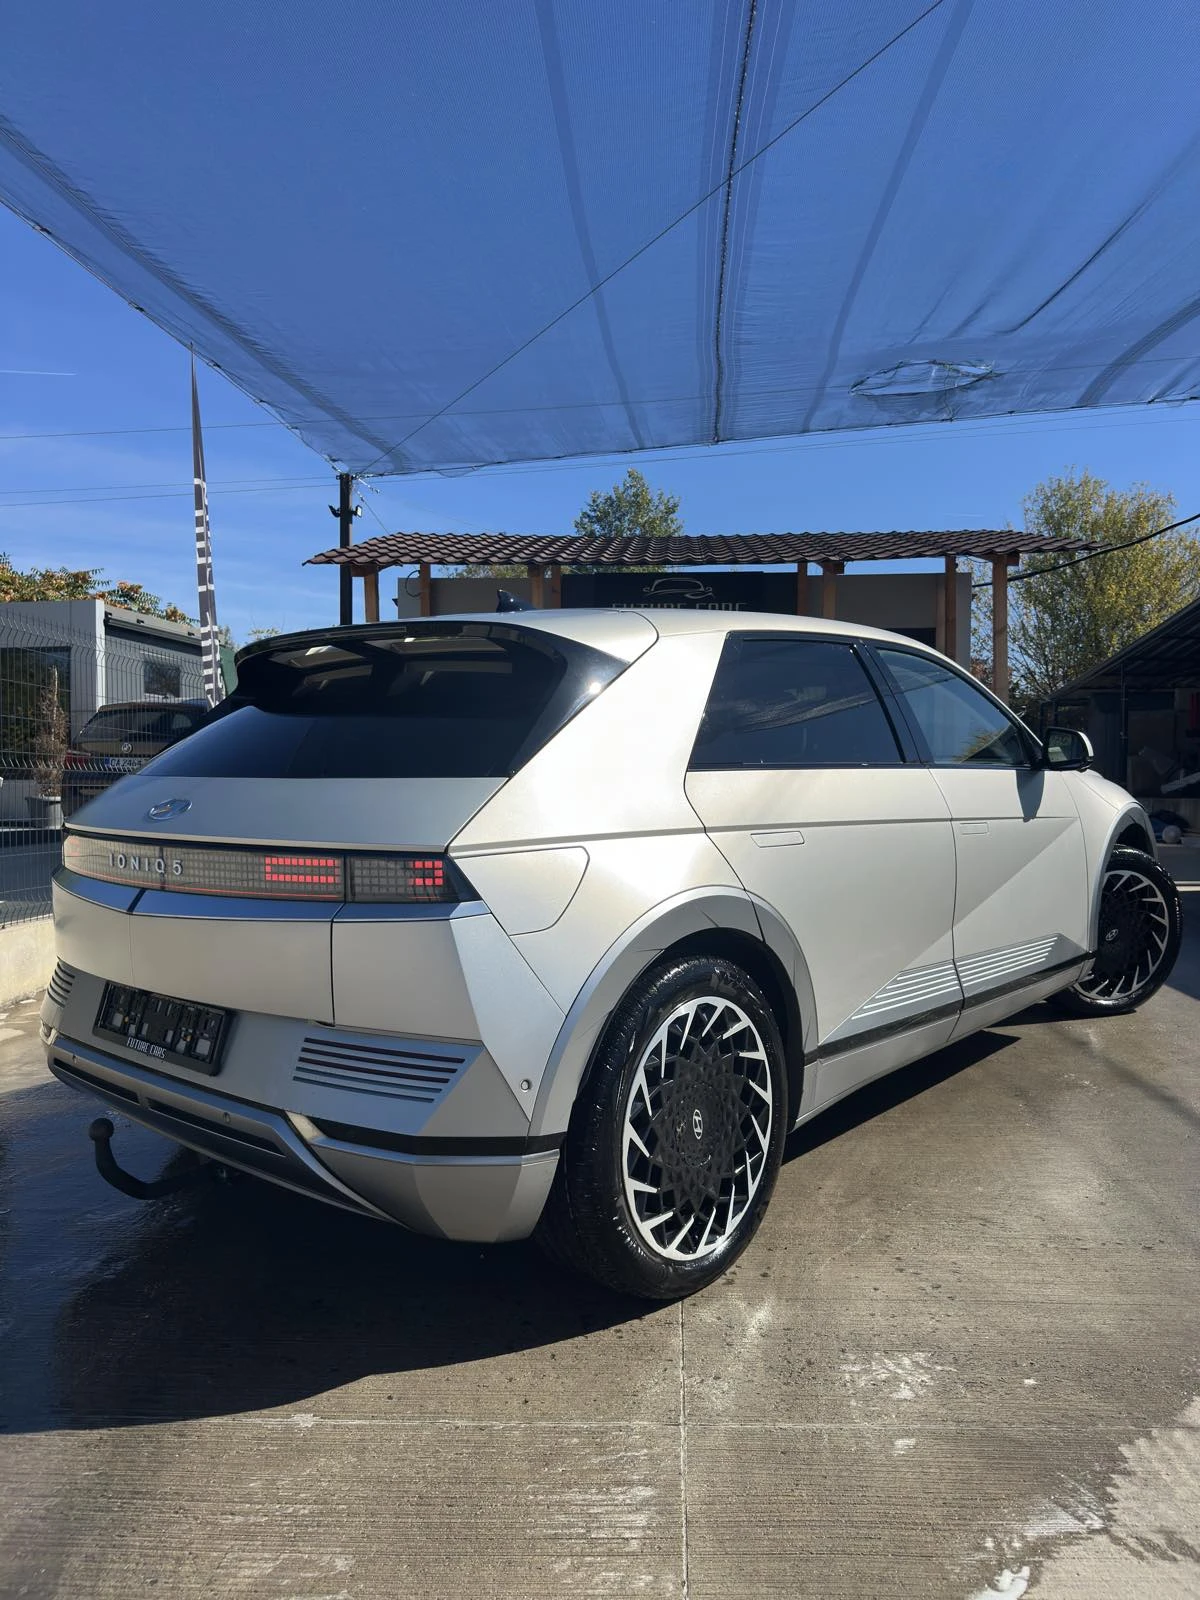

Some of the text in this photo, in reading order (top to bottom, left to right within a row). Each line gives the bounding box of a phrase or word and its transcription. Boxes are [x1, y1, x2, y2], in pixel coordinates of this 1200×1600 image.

[109, 853, 183, 876] IONIQ 5
[127, 1036, 167, 1059] FUTURE CARS
